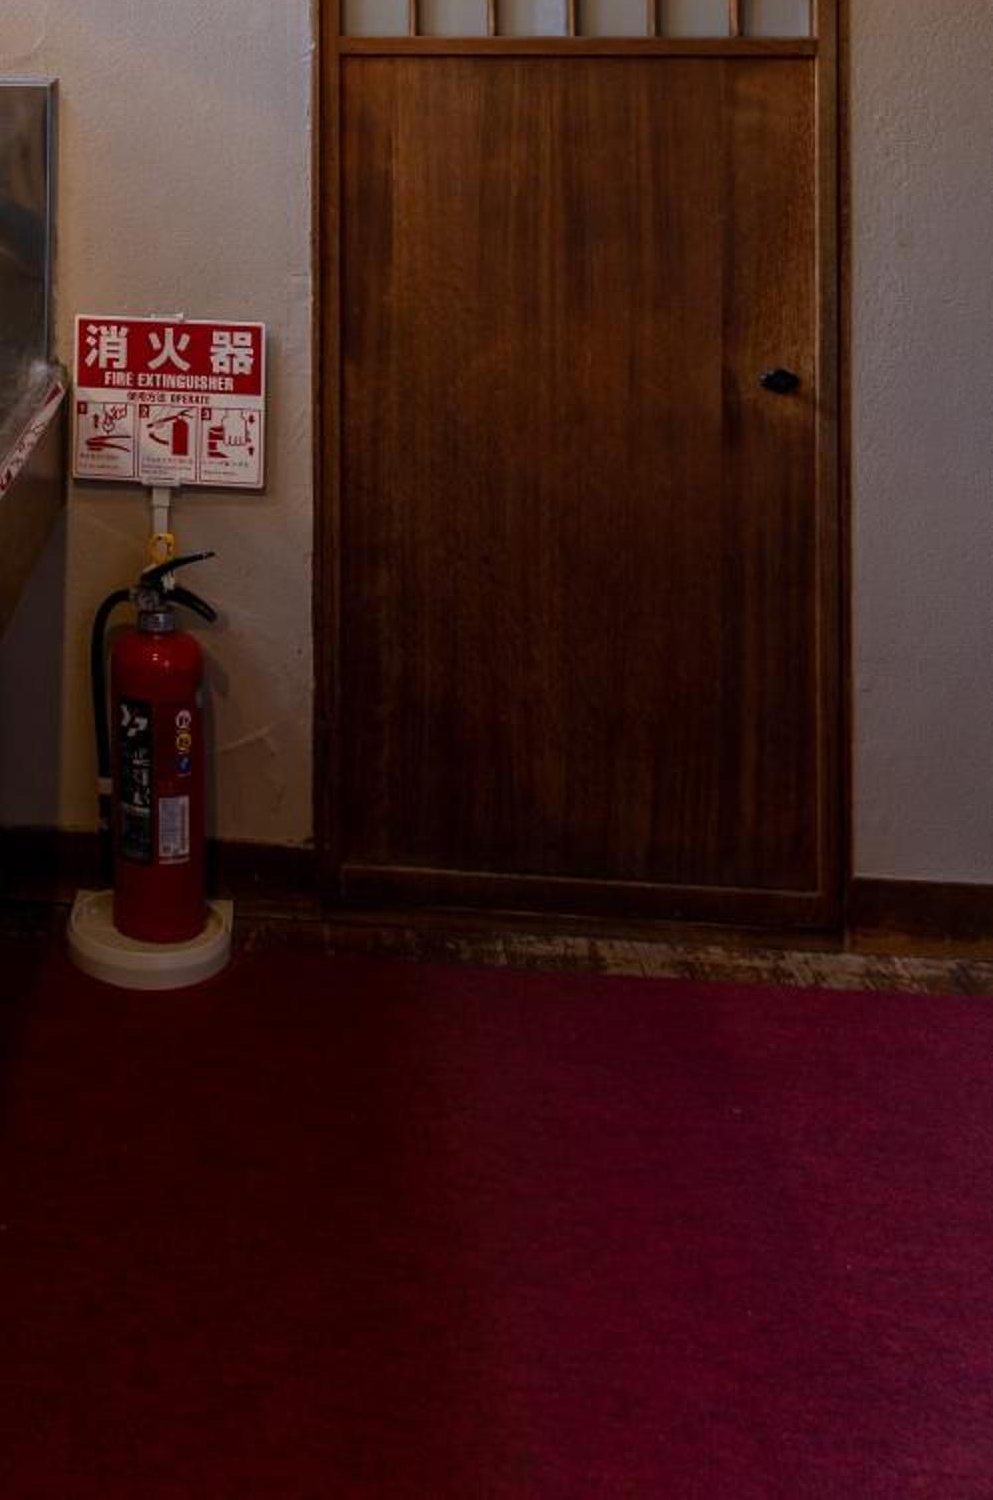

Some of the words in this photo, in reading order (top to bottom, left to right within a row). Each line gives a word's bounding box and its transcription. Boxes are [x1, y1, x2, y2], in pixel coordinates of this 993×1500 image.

[85, 324, 254, 374] 消火器
[104, 372, 133, 386] FIRE
[138, 374, 234, 391] EXTINGUISHER
